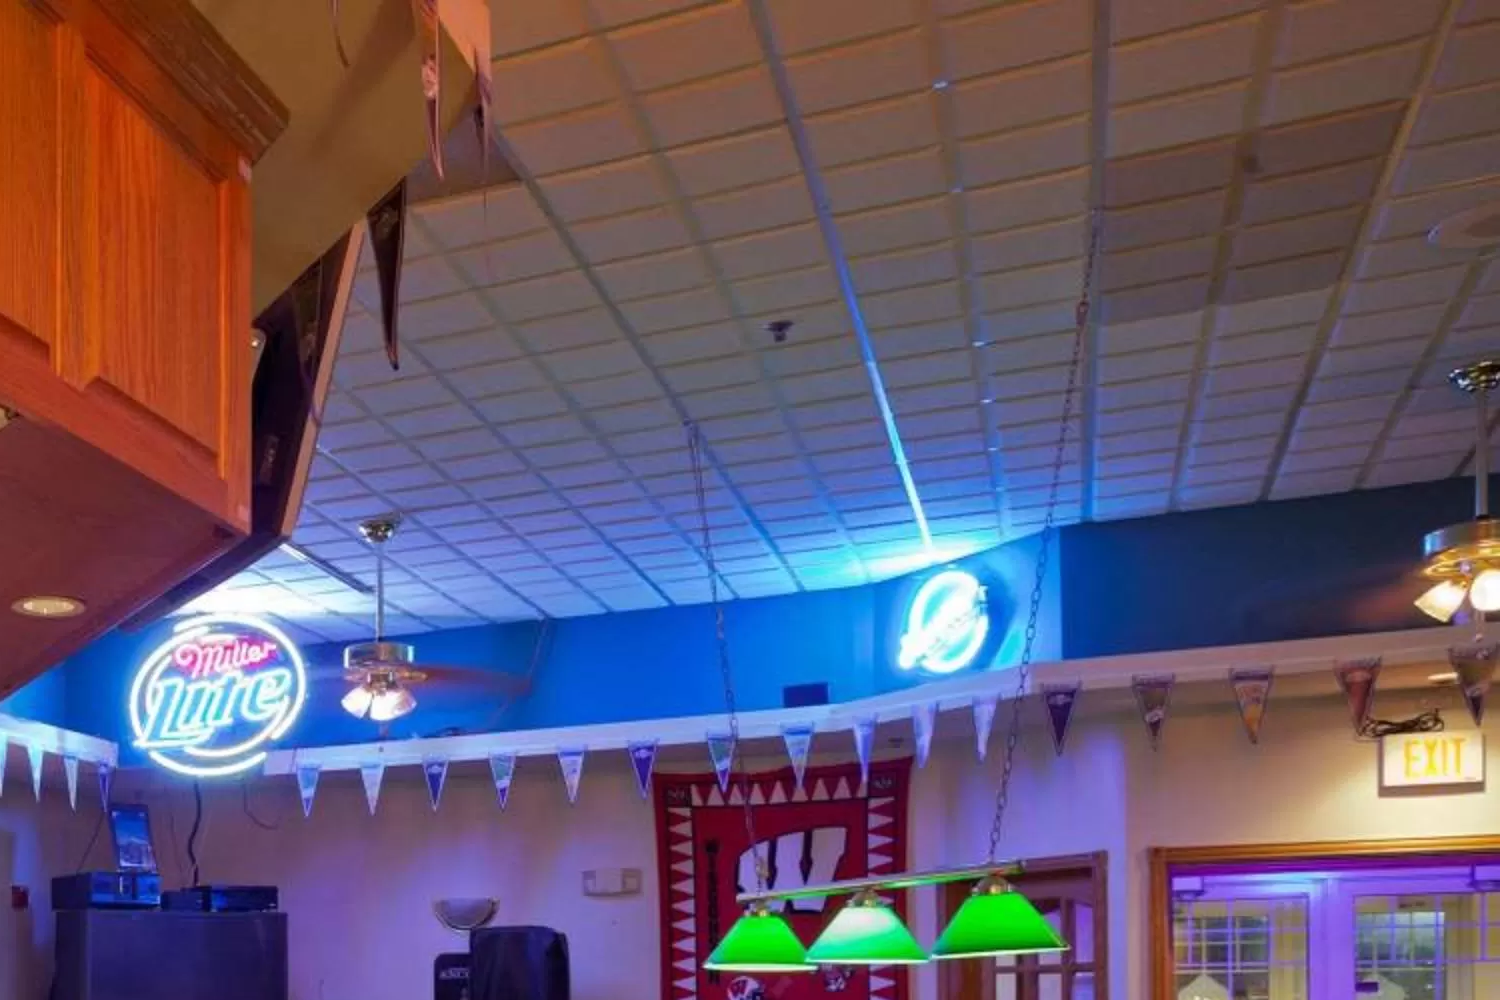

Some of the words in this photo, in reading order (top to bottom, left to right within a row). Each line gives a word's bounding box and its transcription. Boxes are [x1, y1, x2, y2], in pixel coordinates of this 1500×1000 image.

[174, 640, 276, 678] Miller
[133, 667, 292, 748] Lite
[1404, 737, 1467, 777] EXIT
